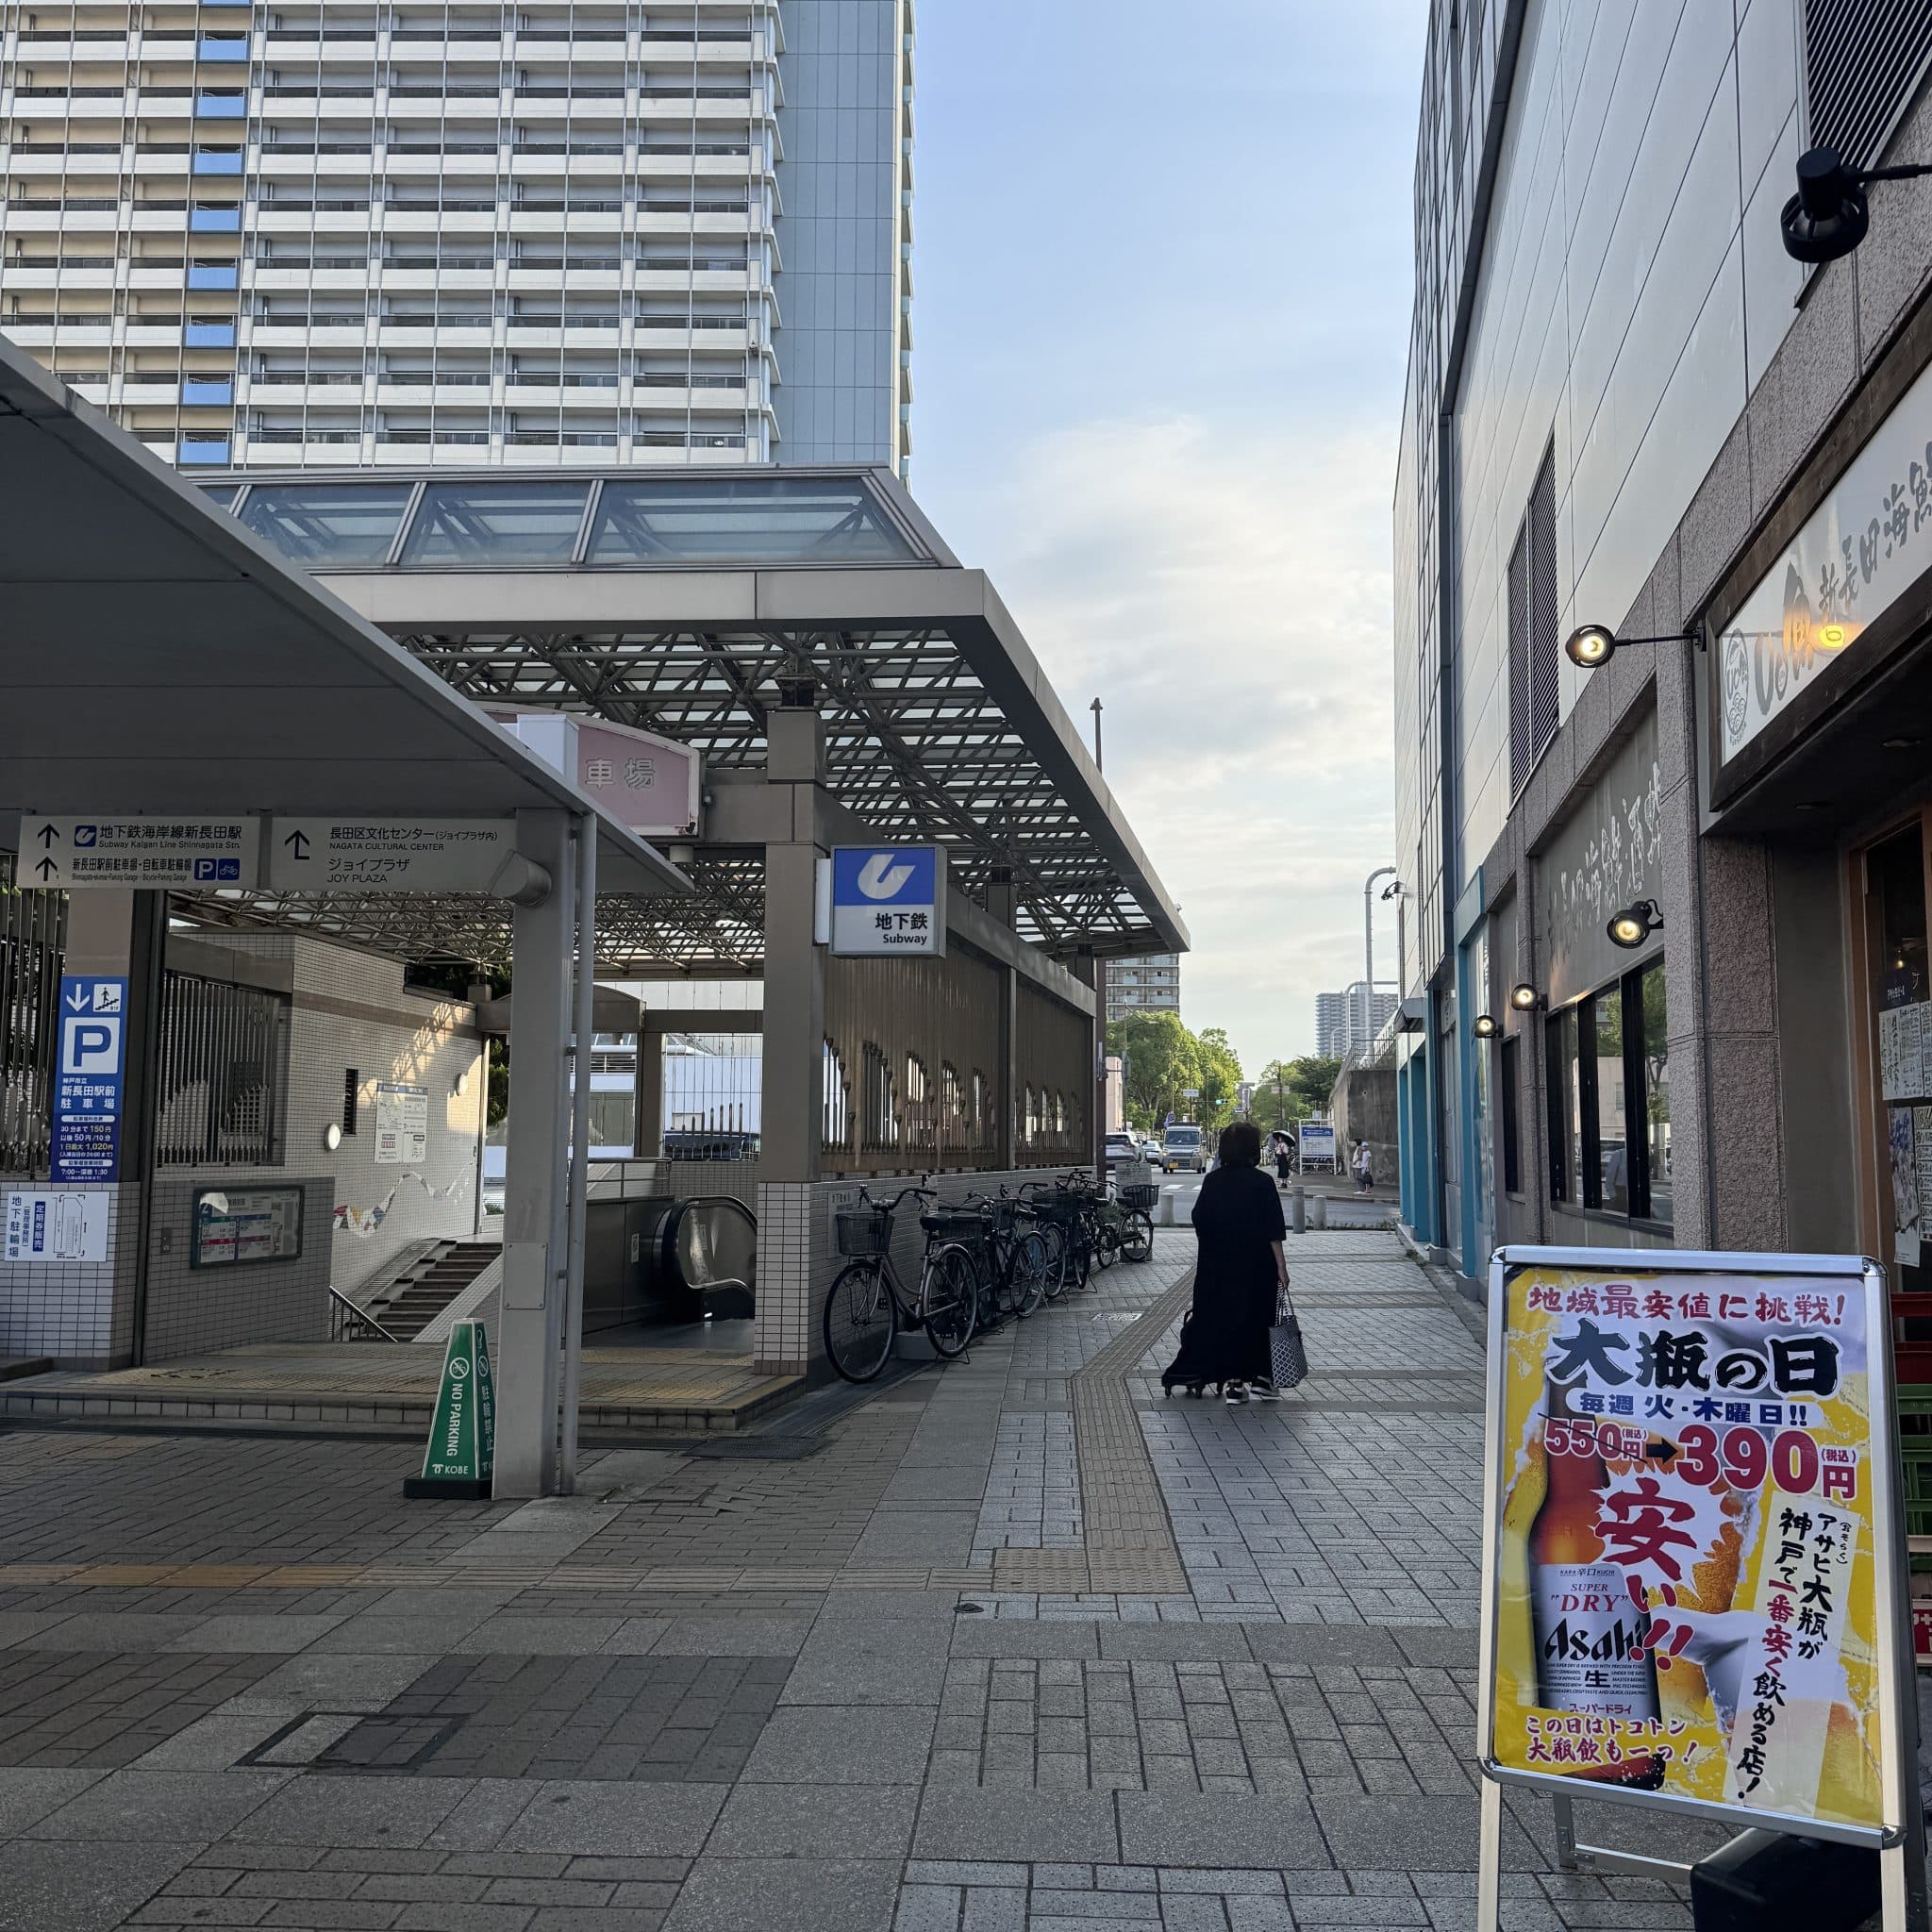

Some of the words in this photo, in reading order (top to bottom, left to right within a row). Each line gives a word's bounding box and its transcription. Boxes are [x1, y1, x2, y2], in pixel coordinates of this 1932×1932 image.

[99, 824, 242, 840] 地下鉄海岸線新長田駅
[98, 841, 128, 849] Subway
[159, 841, 176, 849] Line
[365, 842, 408, 851] CULTURAL
[327, 858, 410, 872] ジョイプラザ
[326, 874, 350, 883] JOY
[352, 874, 388, 883] PLAZA
[874, 912, 928, 930] 地下鉄
[882, 934, 927, 945] Subway
[73, 1024, 112, 1067] P
[61, 1085, 115, 1096] 新長田駅前
[60, 1097, 115, 1108] 駐車場
[1527, 1285, 1845, 1325] 地域最安値に挑戦!
[1546, 1318, 1840, 1396] 大瓶の日
[451, 1383, 463, 1400] NO
[446, 1405, 462, 1457] PARKING
[444, 1465, 469, 1474] KOBE
[1570, 1583, 1608, 1591] SUPER
[1796, 1512, 1838, 1660] アサヒ大瓶が
[1736, 1507, 1813, 1800] 神戸で一番安く飲める店!
[1585, 1670, 1610, 1688] 生
[1569, 1703, 1632, 1714] スーパードライ
[1526, 1717, 1687, 1735] この日はトコトン
